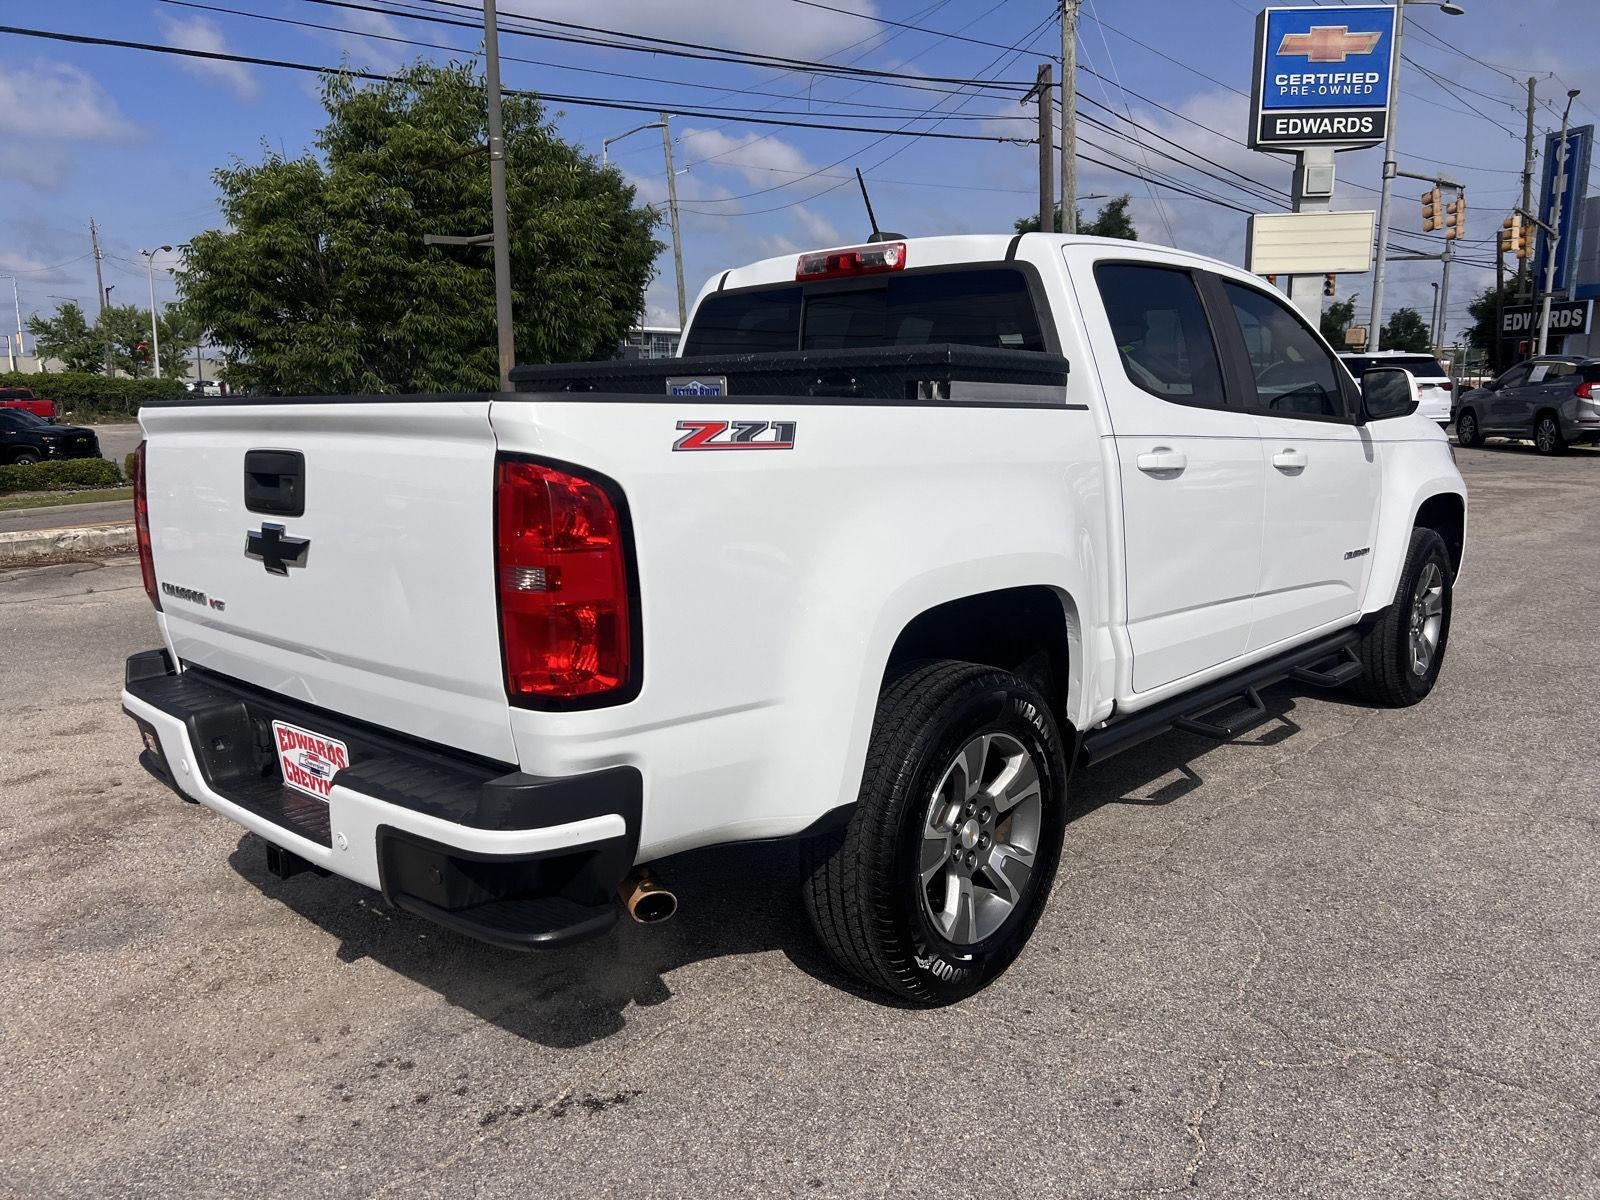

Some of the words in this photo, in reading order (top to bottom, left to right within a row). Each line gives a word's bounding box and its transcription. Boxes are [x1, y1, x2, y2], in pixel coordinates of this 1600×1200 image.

[1275, 72, 1380, 86] CERTIFIED
[1280, 84, 1373, 96] PRE-OWNED
[1275, 117, 1373, 135] EDWARDS
[672, 420, 797, 452] Z71
[208, 598, 226, 612] V6
[276, 727, 347, 769] EDWARDS
